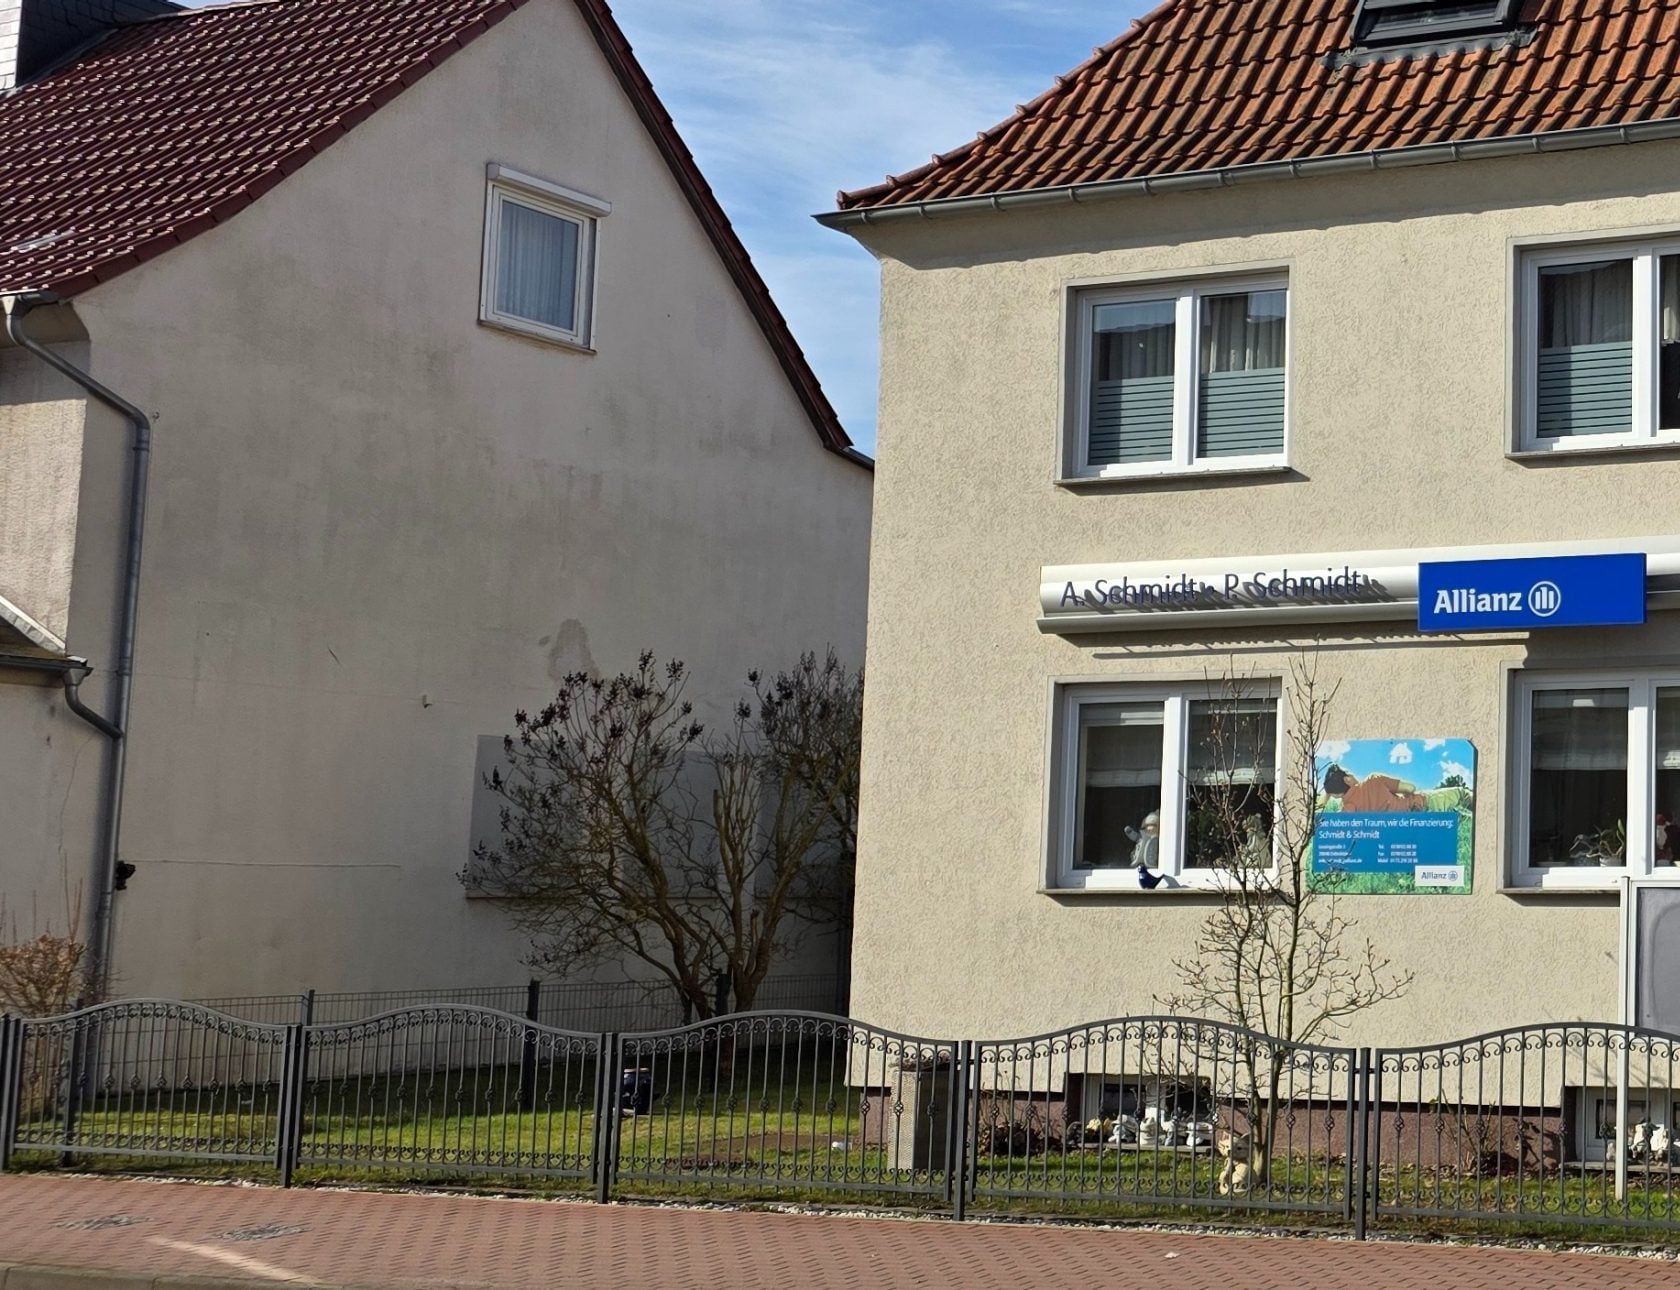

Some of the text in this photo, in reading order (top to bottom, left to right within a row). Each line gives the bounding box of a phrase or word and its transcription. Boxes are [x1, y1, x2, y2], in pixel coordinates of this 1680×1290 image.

[1059, 565, 1362, 607] A. Schmidt P. Schmidt
[1433, 589, 1522, 614] Allianz
[1318, 830, 1380, 839] Schmidt & Schmidt
[1421, 871, 1447, 880] Allianz
